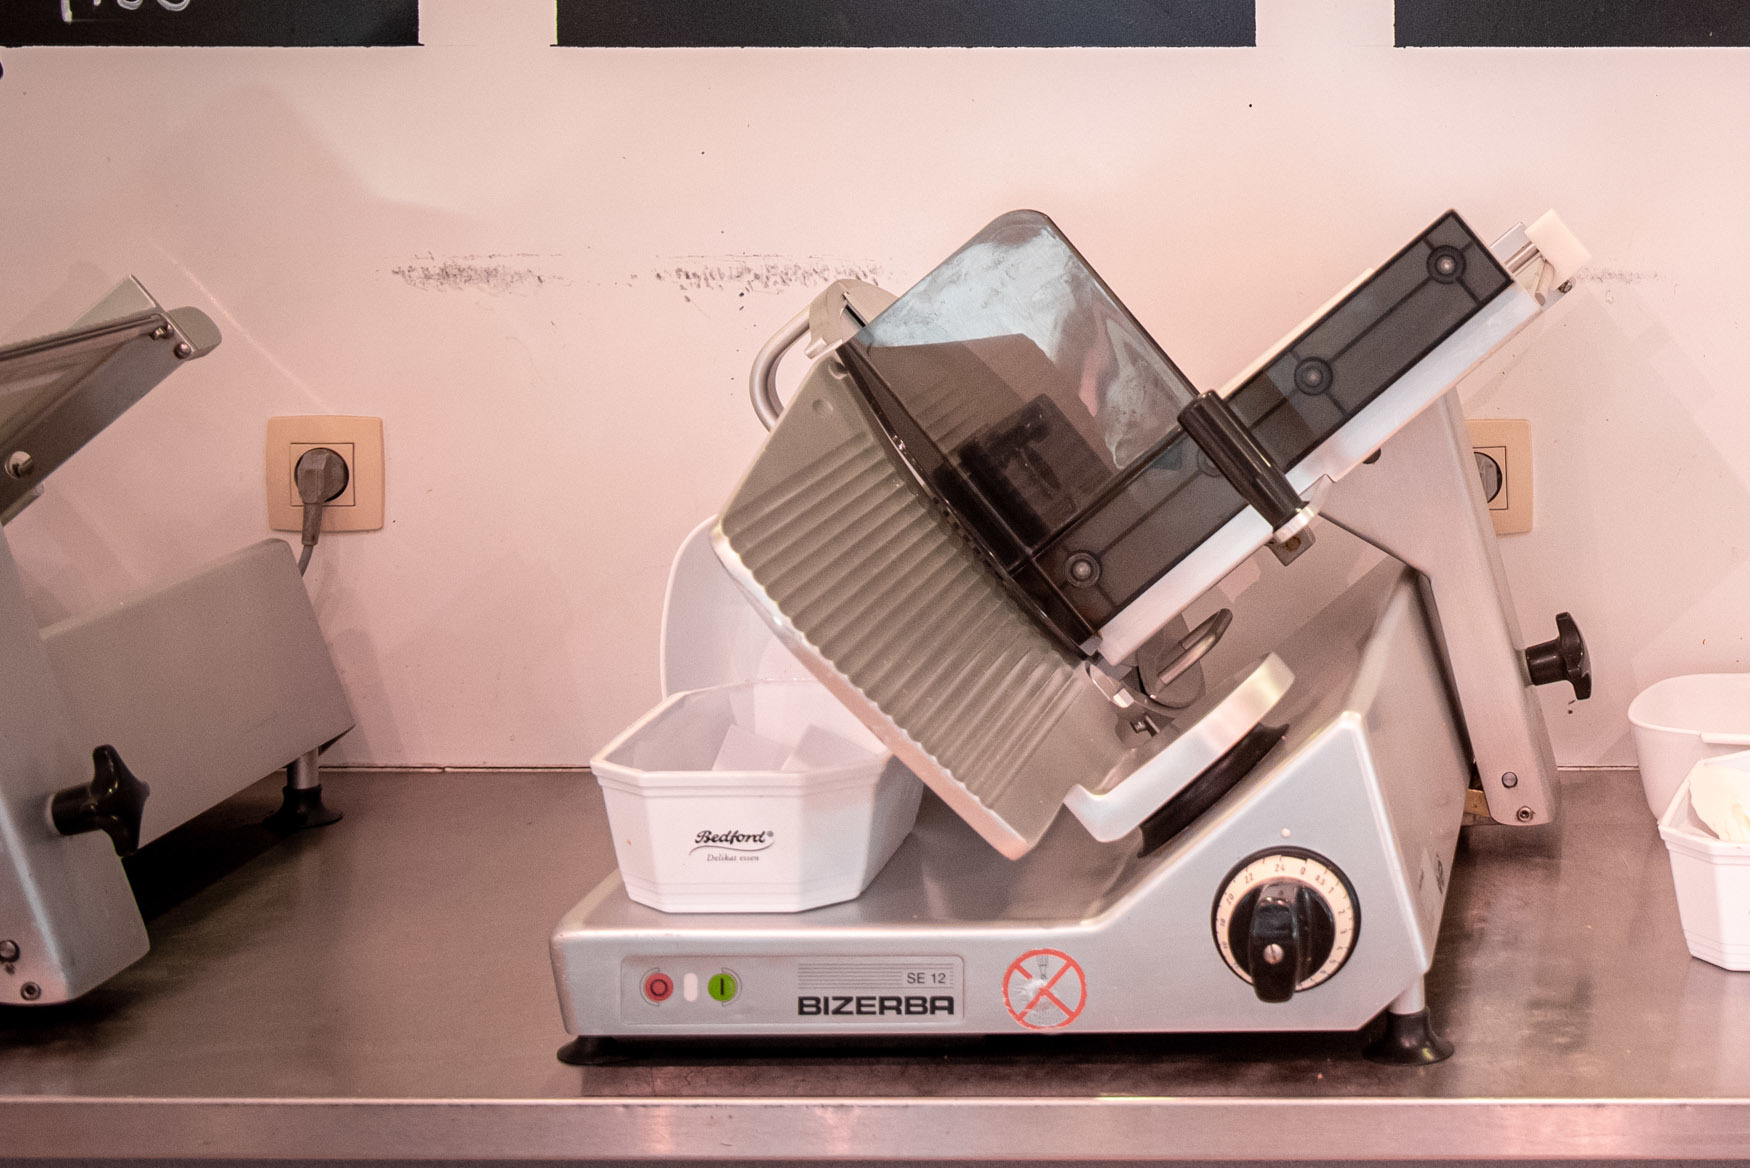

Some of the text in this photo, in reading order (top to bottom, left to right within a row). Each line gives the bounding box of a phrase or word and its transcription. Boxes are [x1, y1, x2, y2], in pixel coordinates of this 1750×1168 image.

[694, 830, 766, 845] Bedford
[906, 972, 946, 984] SE 12
[797, 995, 955, 1016] BIZERBA
